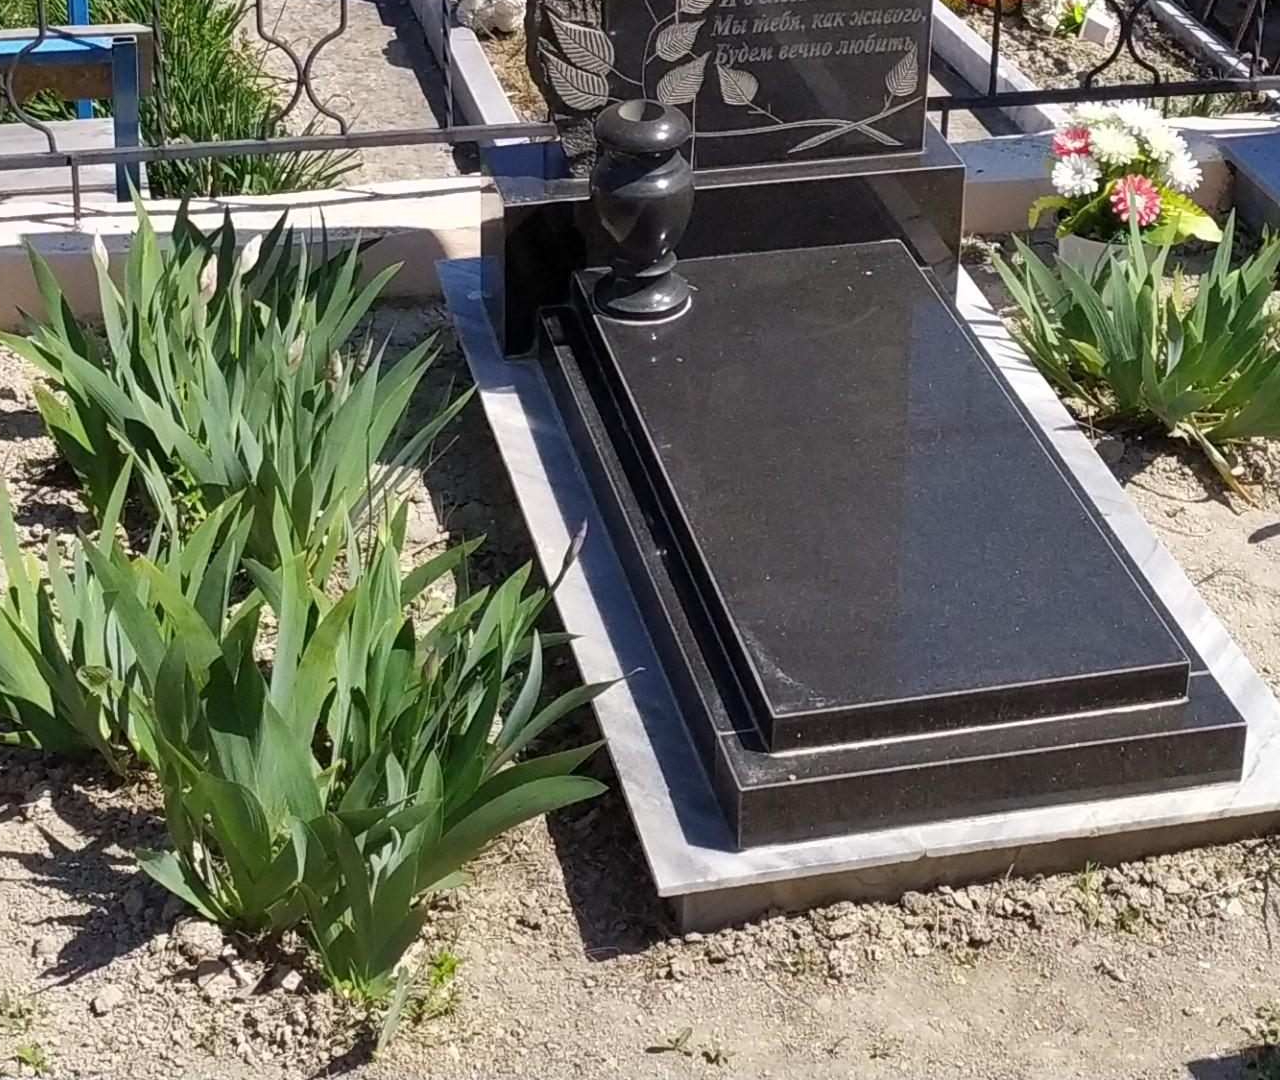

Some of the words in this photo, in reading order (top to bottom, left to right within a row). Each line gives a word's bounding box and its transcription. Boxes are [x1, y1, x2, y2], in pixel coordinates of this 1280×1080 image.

[710, 14, 748, 37] Мы
[811, 10, 846, 29] как
[713, 41, 774, 68] Будем
[778, 42, 833, 59] вечно
